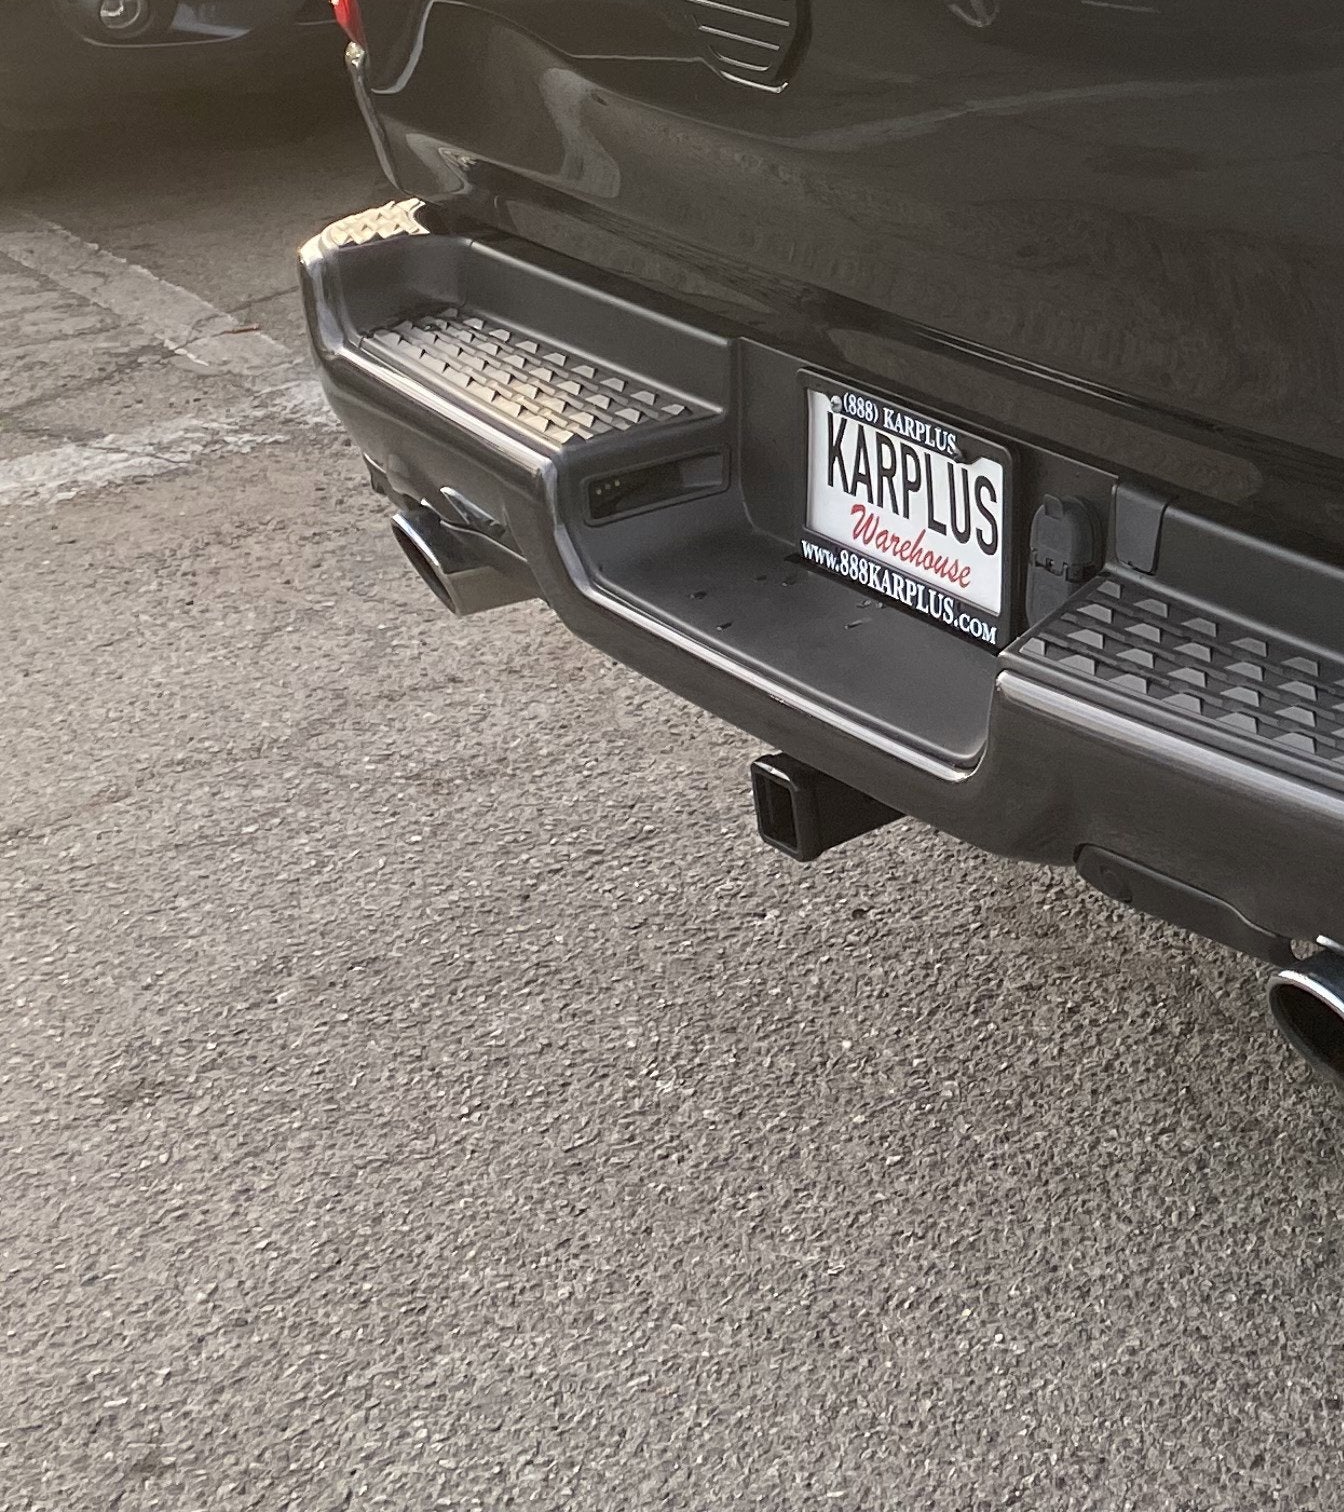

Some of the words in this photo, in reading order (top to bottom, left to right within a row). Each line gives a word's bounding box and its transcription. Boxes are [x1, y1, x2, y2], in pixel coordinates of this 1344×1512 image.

[842, 392, 878, 424] (888)
[882, 406, 958, 455] KARPLUS
[827, 410, 998, 556] KARPLUS
[850, 503, 973, 589] Warehouse
